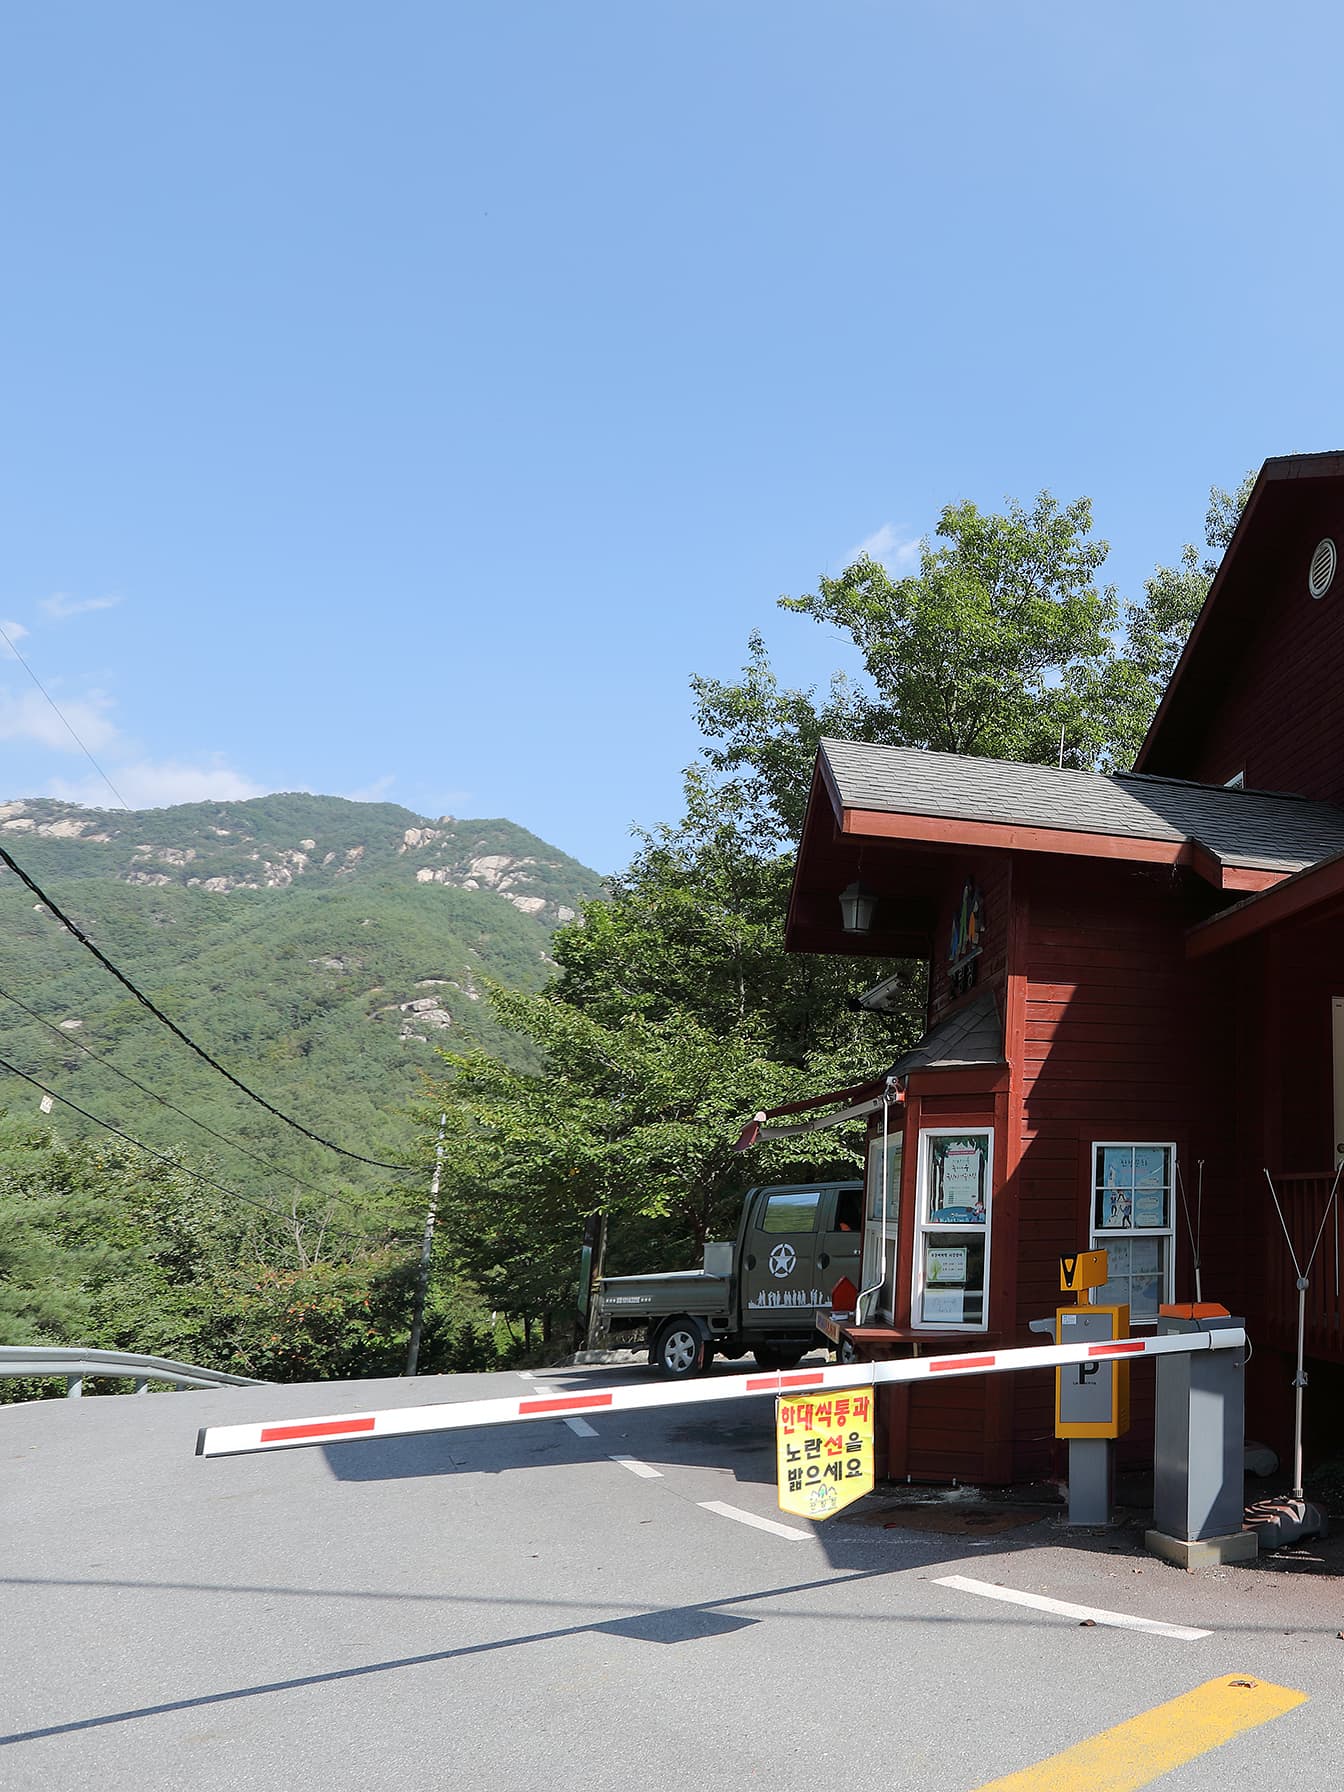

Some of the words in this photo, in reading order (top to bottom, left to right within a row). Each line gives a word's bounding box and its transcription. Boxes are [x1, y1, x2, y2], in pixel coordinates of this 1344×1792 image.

[1079, 1361, 1100, 1385] P
[781, 1396, 870, 1435] 한대씩통과
[786, 1431, 863, 1463] 노란선을
[787, 1458, 863, 1493] 밟으세요
